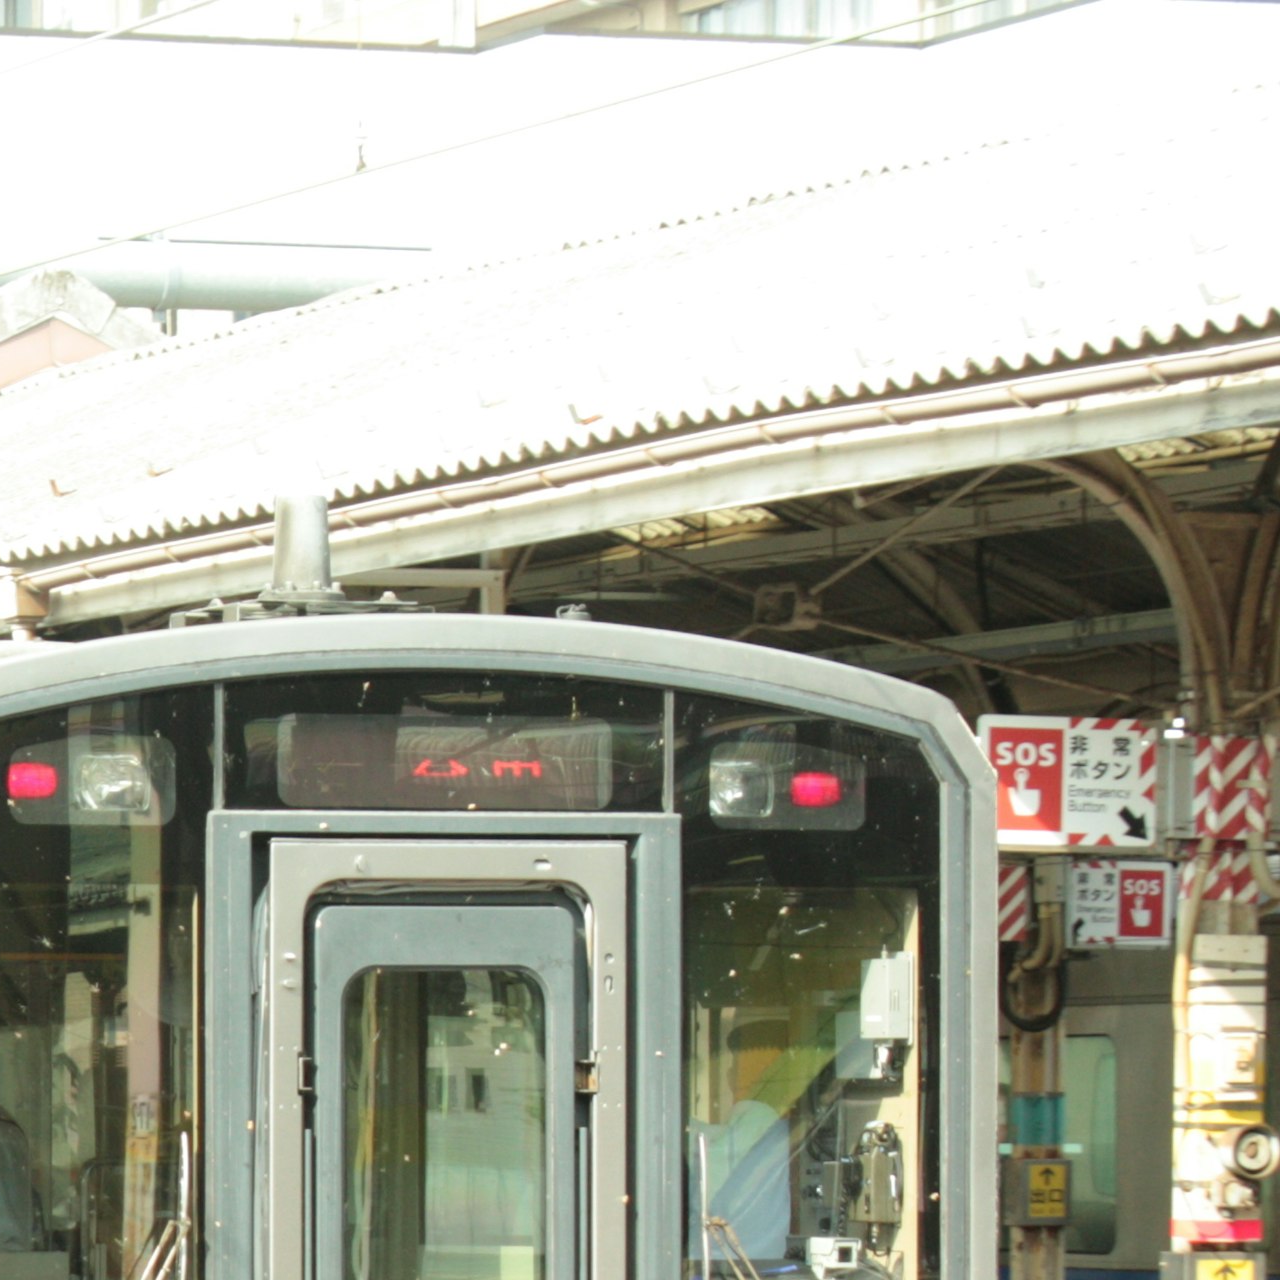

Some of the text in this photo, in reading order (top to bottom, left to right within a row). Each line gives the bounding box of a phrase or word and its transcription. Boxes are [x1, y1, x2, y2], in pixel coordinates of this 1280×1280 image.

[996, 741, 1056, 767] SOS
[1069, 760, 1131, 780] ボタン
[1123, 879, 1161, 896] SOS
[1031, 1189, 1064, 1203] 出口
